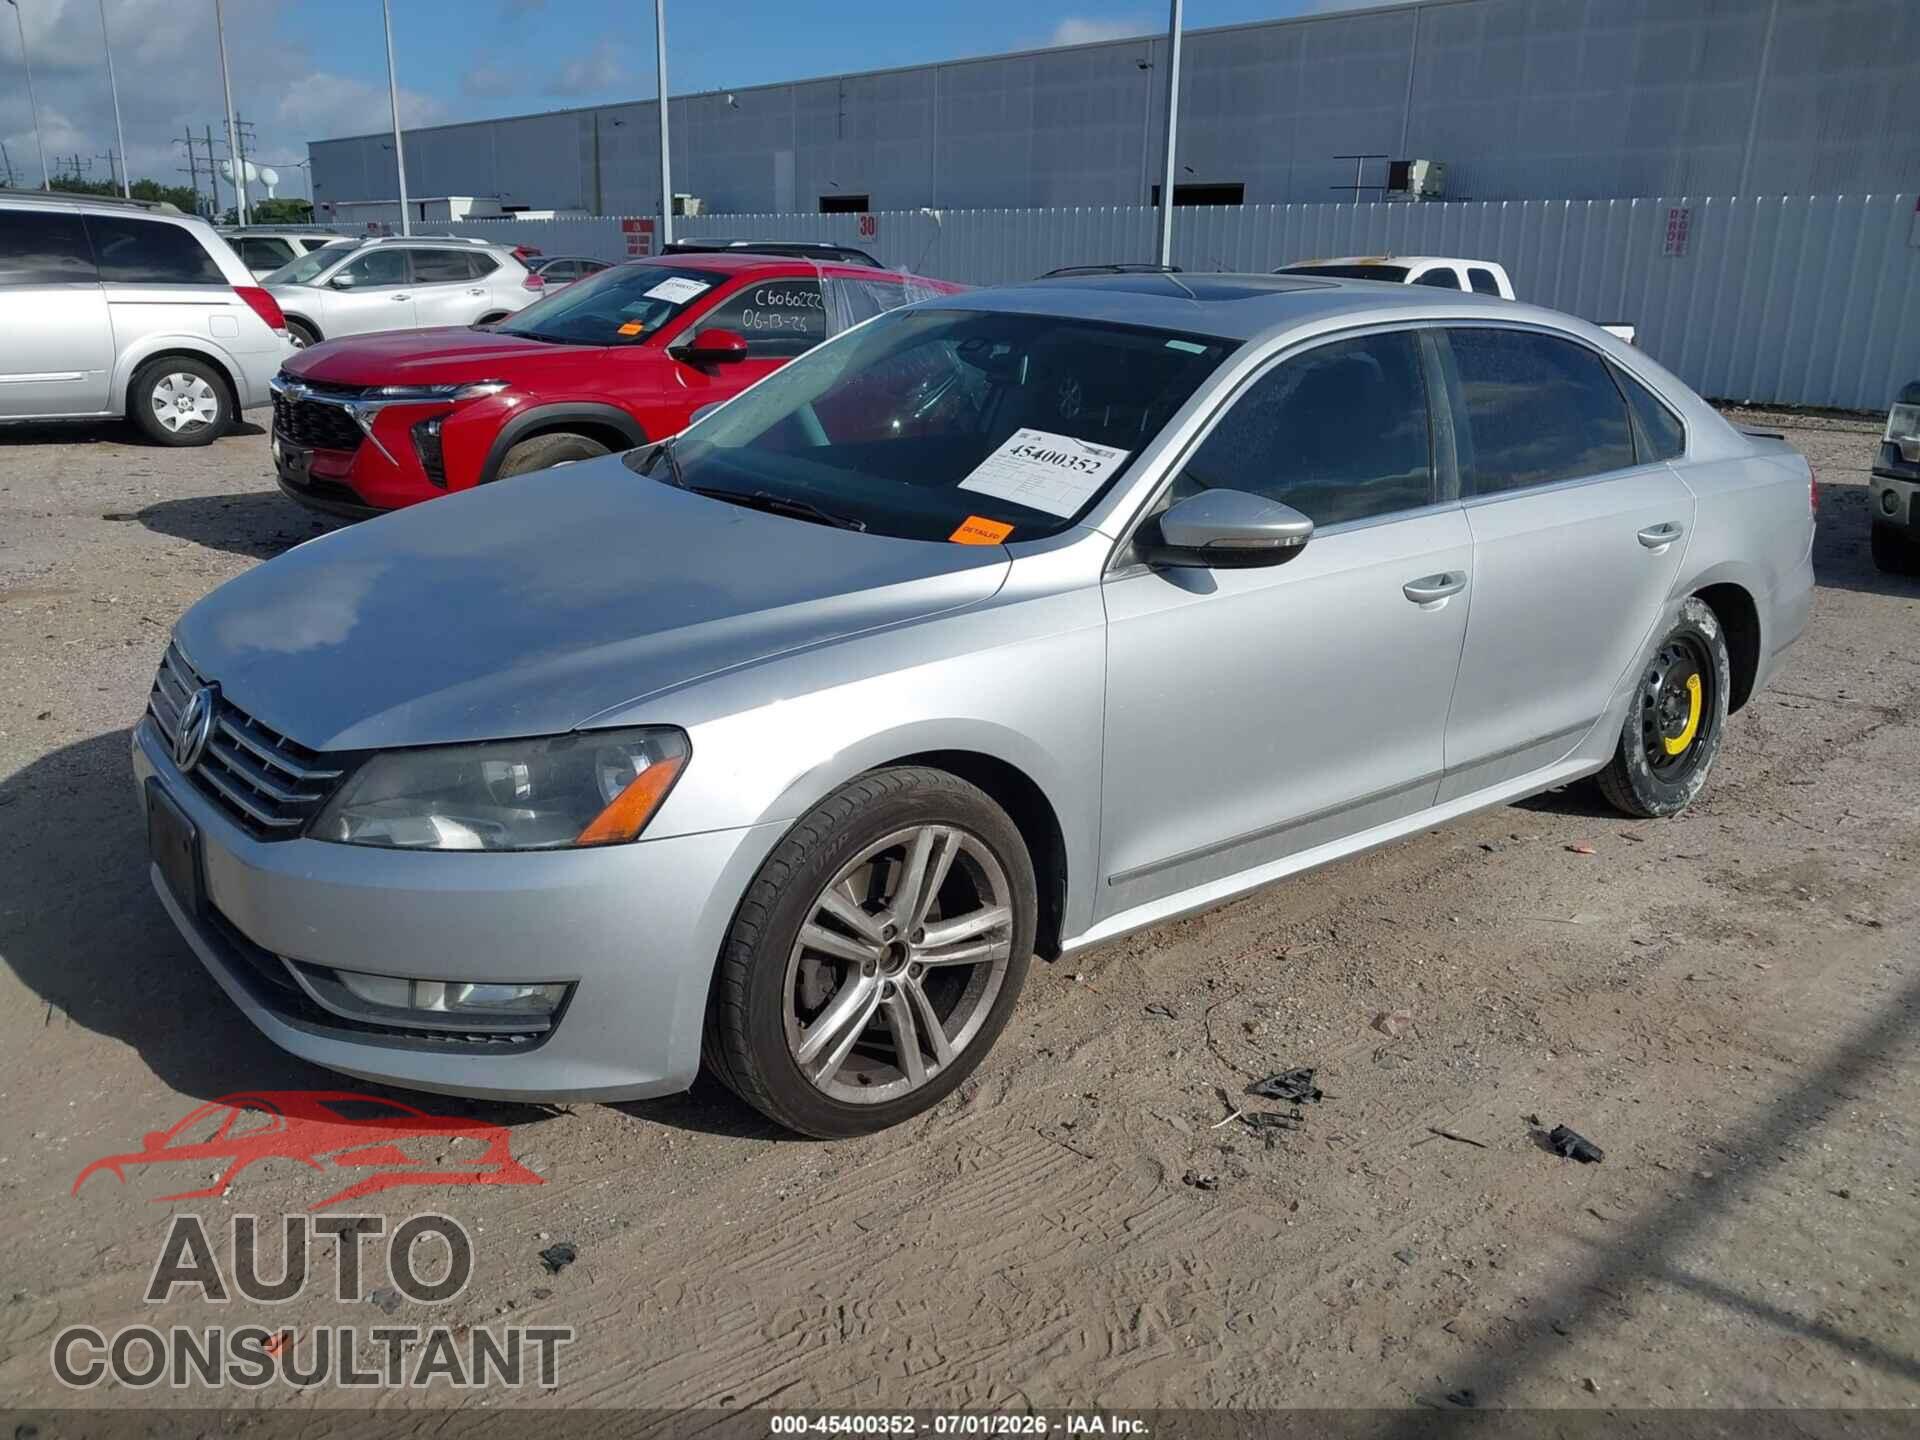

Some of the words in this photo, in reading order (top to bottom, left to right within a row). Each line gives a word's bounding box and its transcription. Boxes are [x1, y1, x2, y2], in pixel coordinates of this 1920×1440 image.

[860, 215, 875, 236] 30
[1009, 444, 1102, 475] 45400352
[962, 526, 1000, 540] DETAILED
